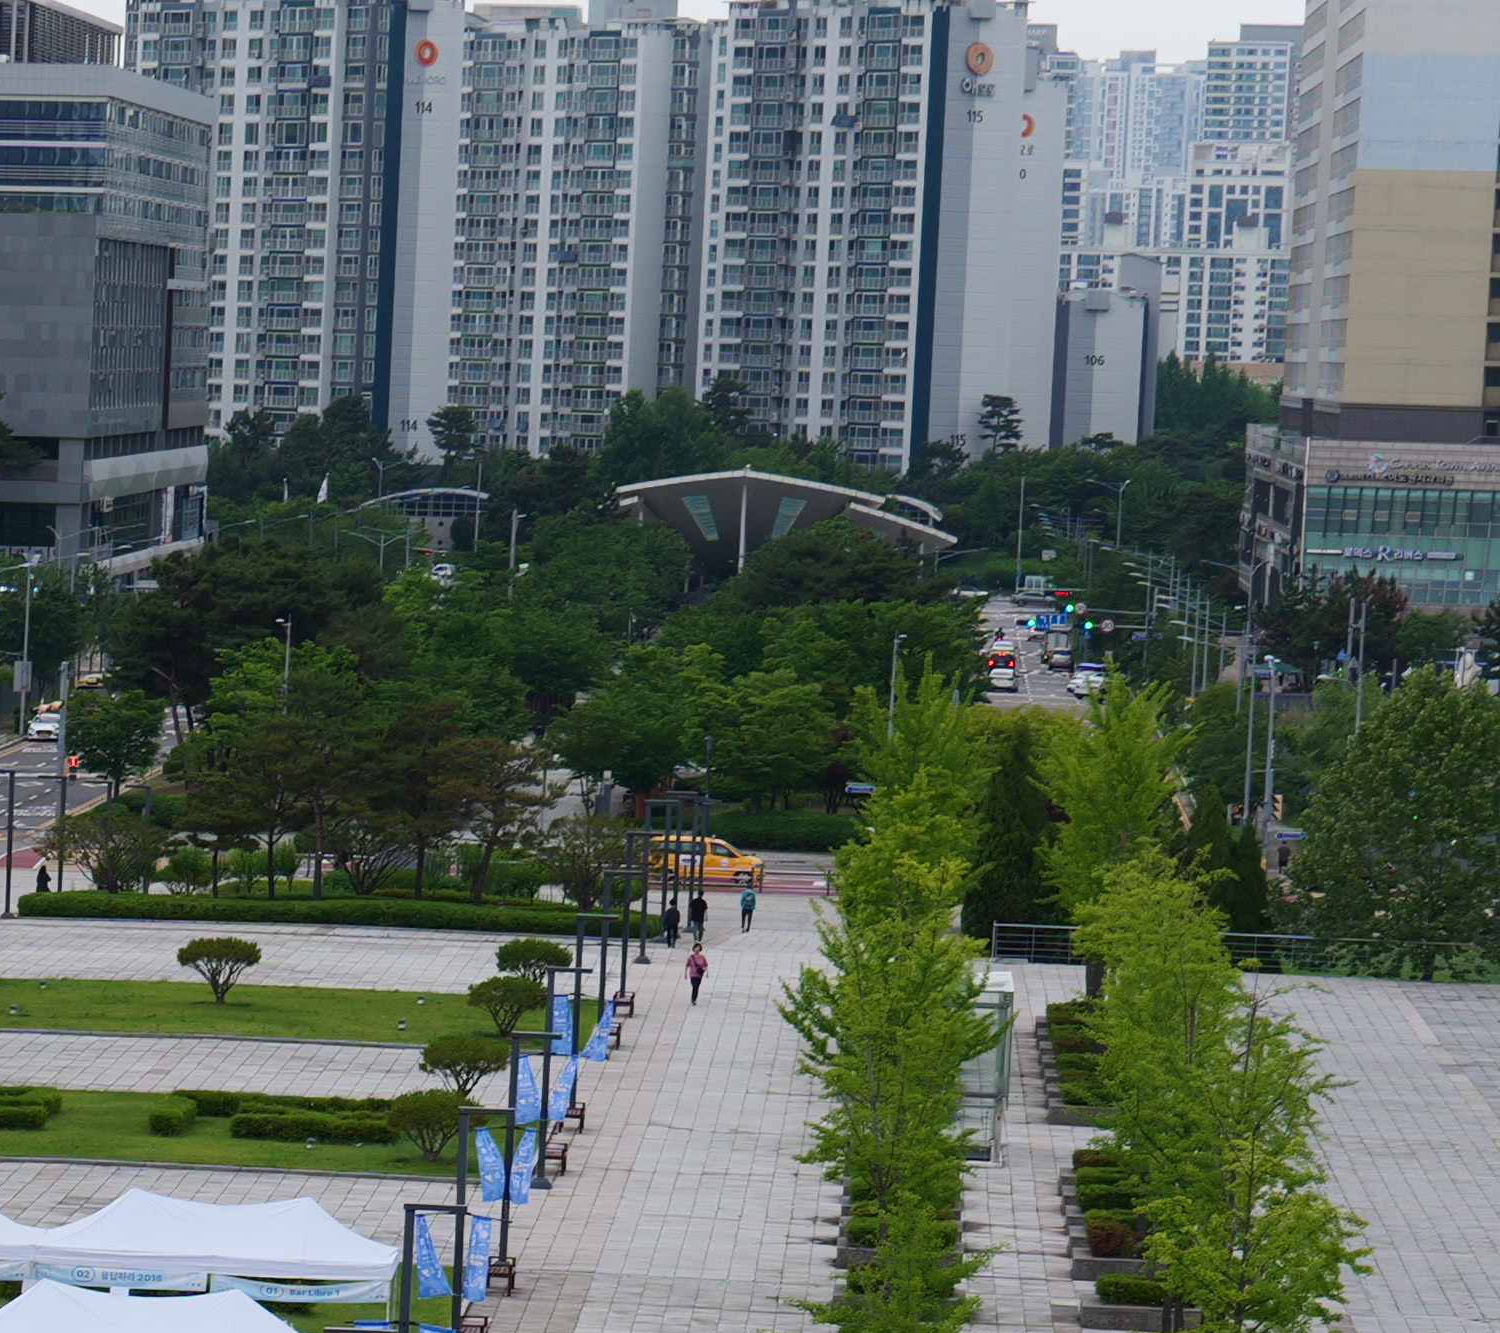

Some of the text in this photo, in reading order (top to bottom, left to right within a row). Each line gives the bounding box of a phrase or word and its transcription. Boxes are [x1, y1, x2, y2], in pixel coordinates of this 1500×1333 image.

[415, 101, 432, 114] 114
[966, 109, 984, 123] 115
[1084, 354, 1105, 366] 106
[400, 419, 417, 432] 114
[950, 434, 966, 447] 115
[77, 1270, 90, 1279] 02
[137, 1273, 162, 1282] 2016
